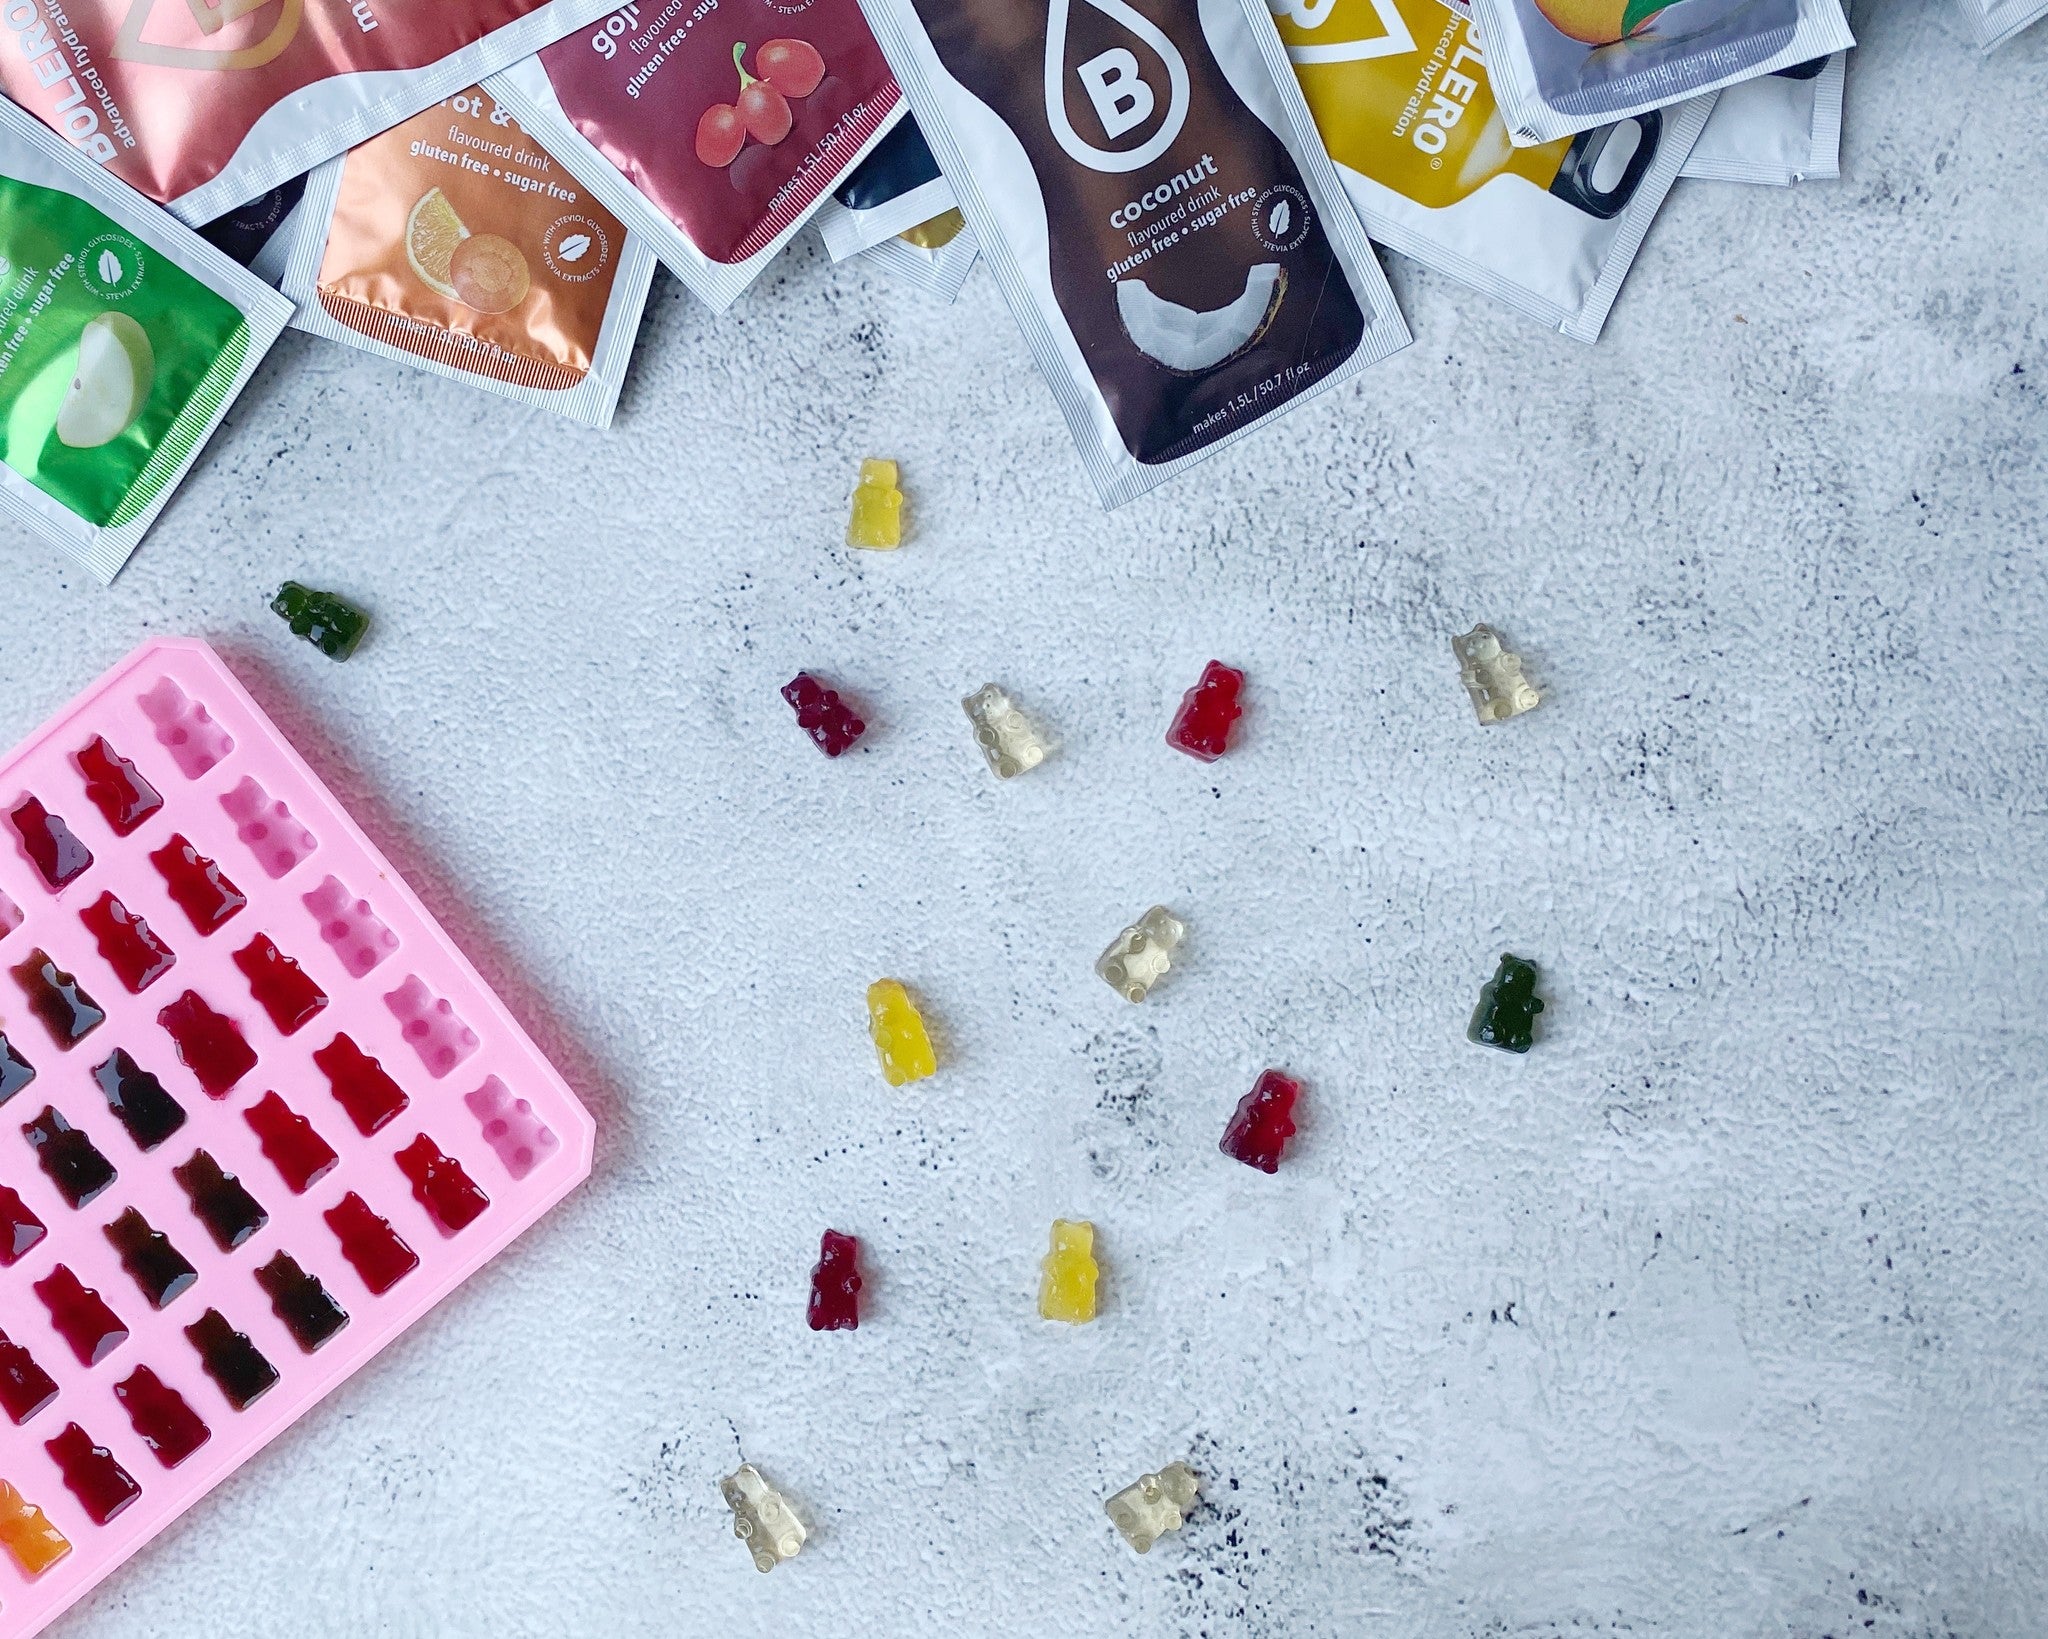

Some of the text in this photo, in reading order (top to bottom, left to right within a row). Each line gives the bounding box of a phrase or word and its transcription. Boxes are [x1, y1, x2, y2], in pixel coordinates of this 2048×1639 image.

[629, 0, 683, 55] flavoured
[3, 0, 118, 165] BOLERO
[625, 53, 665, 99] gluten
[658, 28, 687, 56] free
[1077, 46, 1155, 141] B
[81, 67, 136, 149] advanced
[1392, 59, 1443, 138] hydration
[410, 139, 577, 204] gluten free sugar free
[448, 124, 513, 160] flavoured
[514, 148, 551, 173] drink
[768, 175, 801, 211] makes
[1110, 153, 1219, 229] coconut
[1127, 185, 1222, 248] flavoured drink
[1251, 184, 1311, 252] WITH STEVIOL GLYCOSIDES STEVIA EXTRACTS
[77, 248, 90, 278] STEVIOL
[88, 234, 134, 248] GLYCOSIDES
[543, 214, 608, 282] WITH STEVIOL GLYCOSIDES STEVIA EXTRACTS
[1106, 187, 1257, 283] gluten free sugar free
[4, 325, 29, 353] free
[29, 278, 56, 317] sugar
[49, 253, 75, 280] free
[12, 266, 39, 299] drink
[105, 289, 133, 300] STEVIA
[131, 251, 145, 290] EXTRACTS
[1193, 408, 1227, 434] makes
[1285, 367, 1295, 380] fl
[1296, 362, 1311, 375] oz
